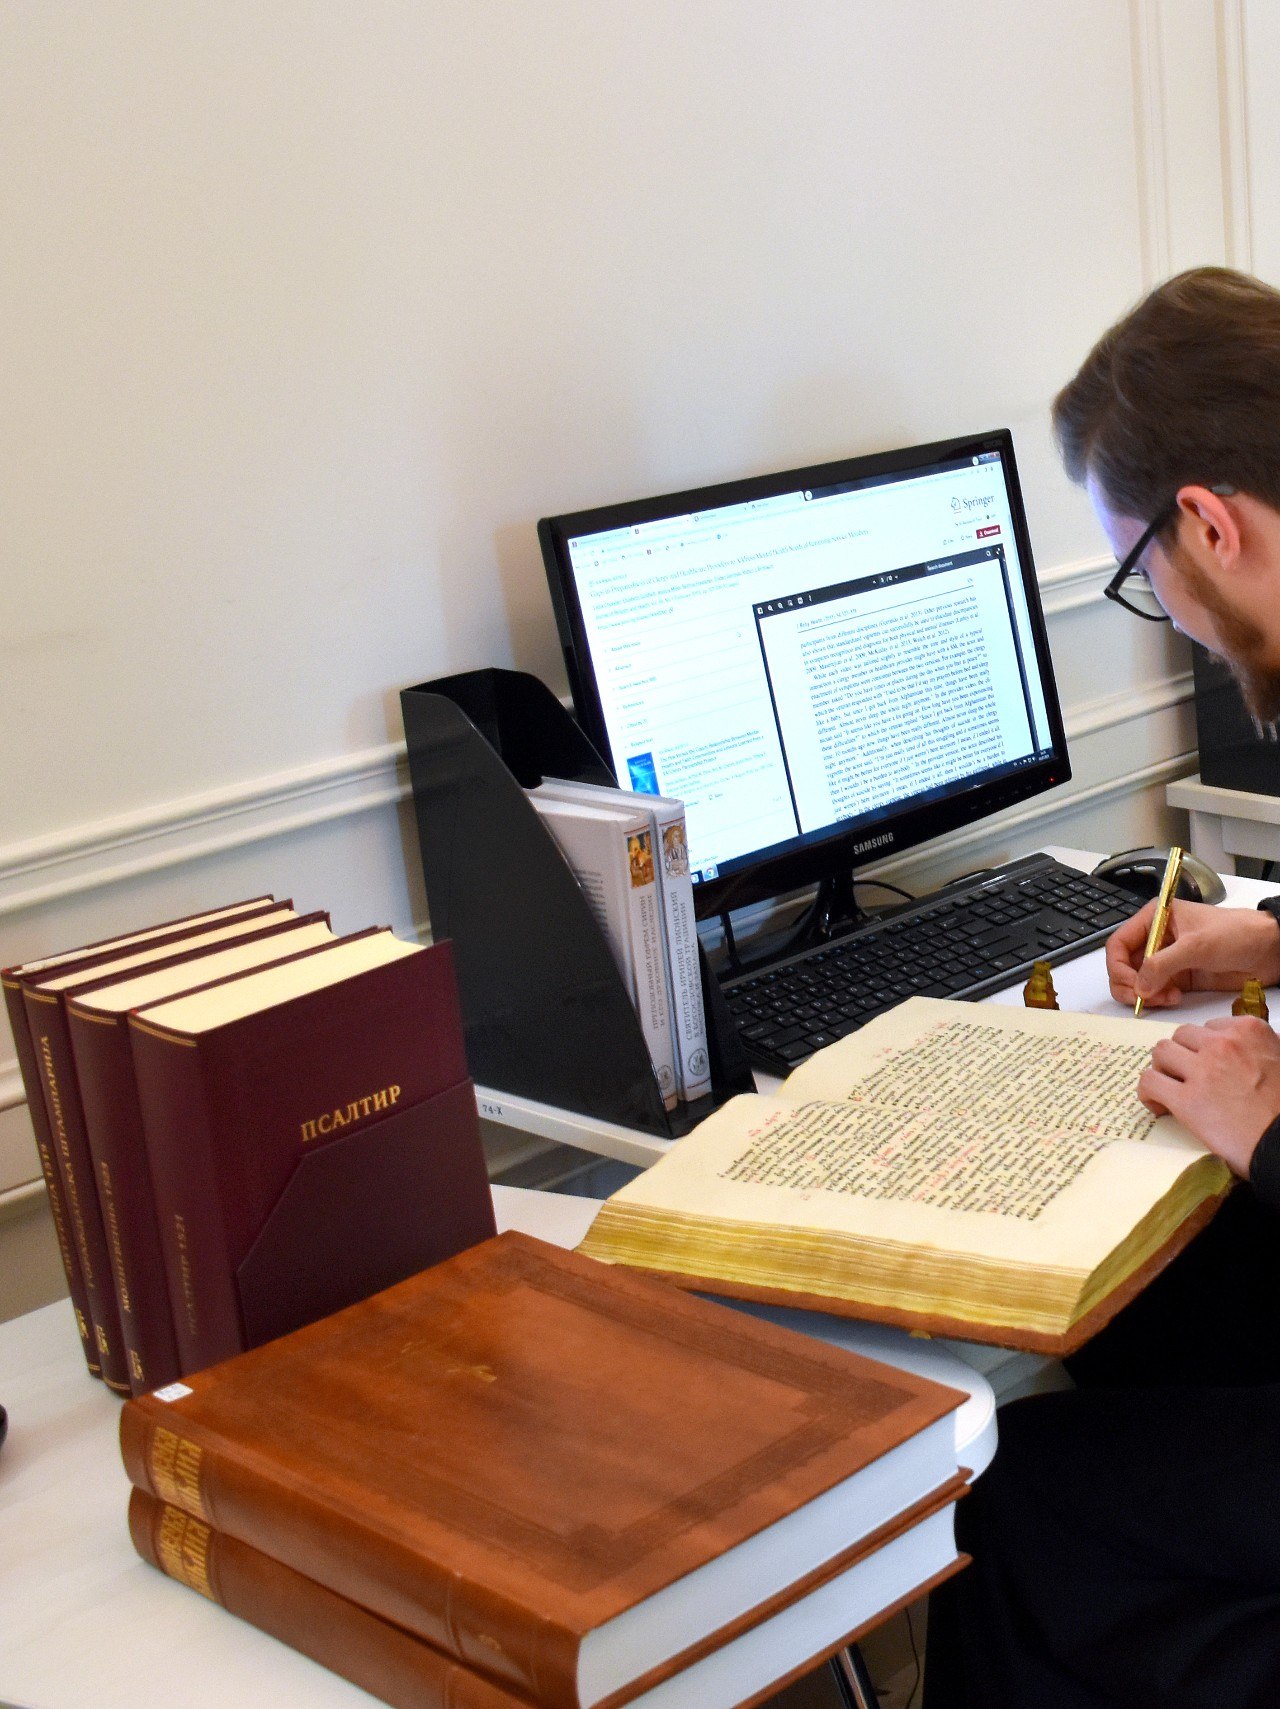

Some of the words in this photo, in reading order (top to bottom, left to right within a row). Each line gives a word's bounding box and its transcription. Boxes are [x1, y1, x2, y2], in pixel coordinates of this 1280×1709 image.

[963, 495, 994, 511] Springer
[853, 832, 894, 855] SAMSUNG
[671, 892, 682, 945] ЛИОНСКИЙ
[676, 947, 686, 986] ИРИНЕЙ
[682, 989, 692, 1040] СВЯТИТЕЛЬ
[40, 1034, 71, 1157] ШТАМПАРИЈА
[300, 1084, 401, 1143] ПСАЛТИР
